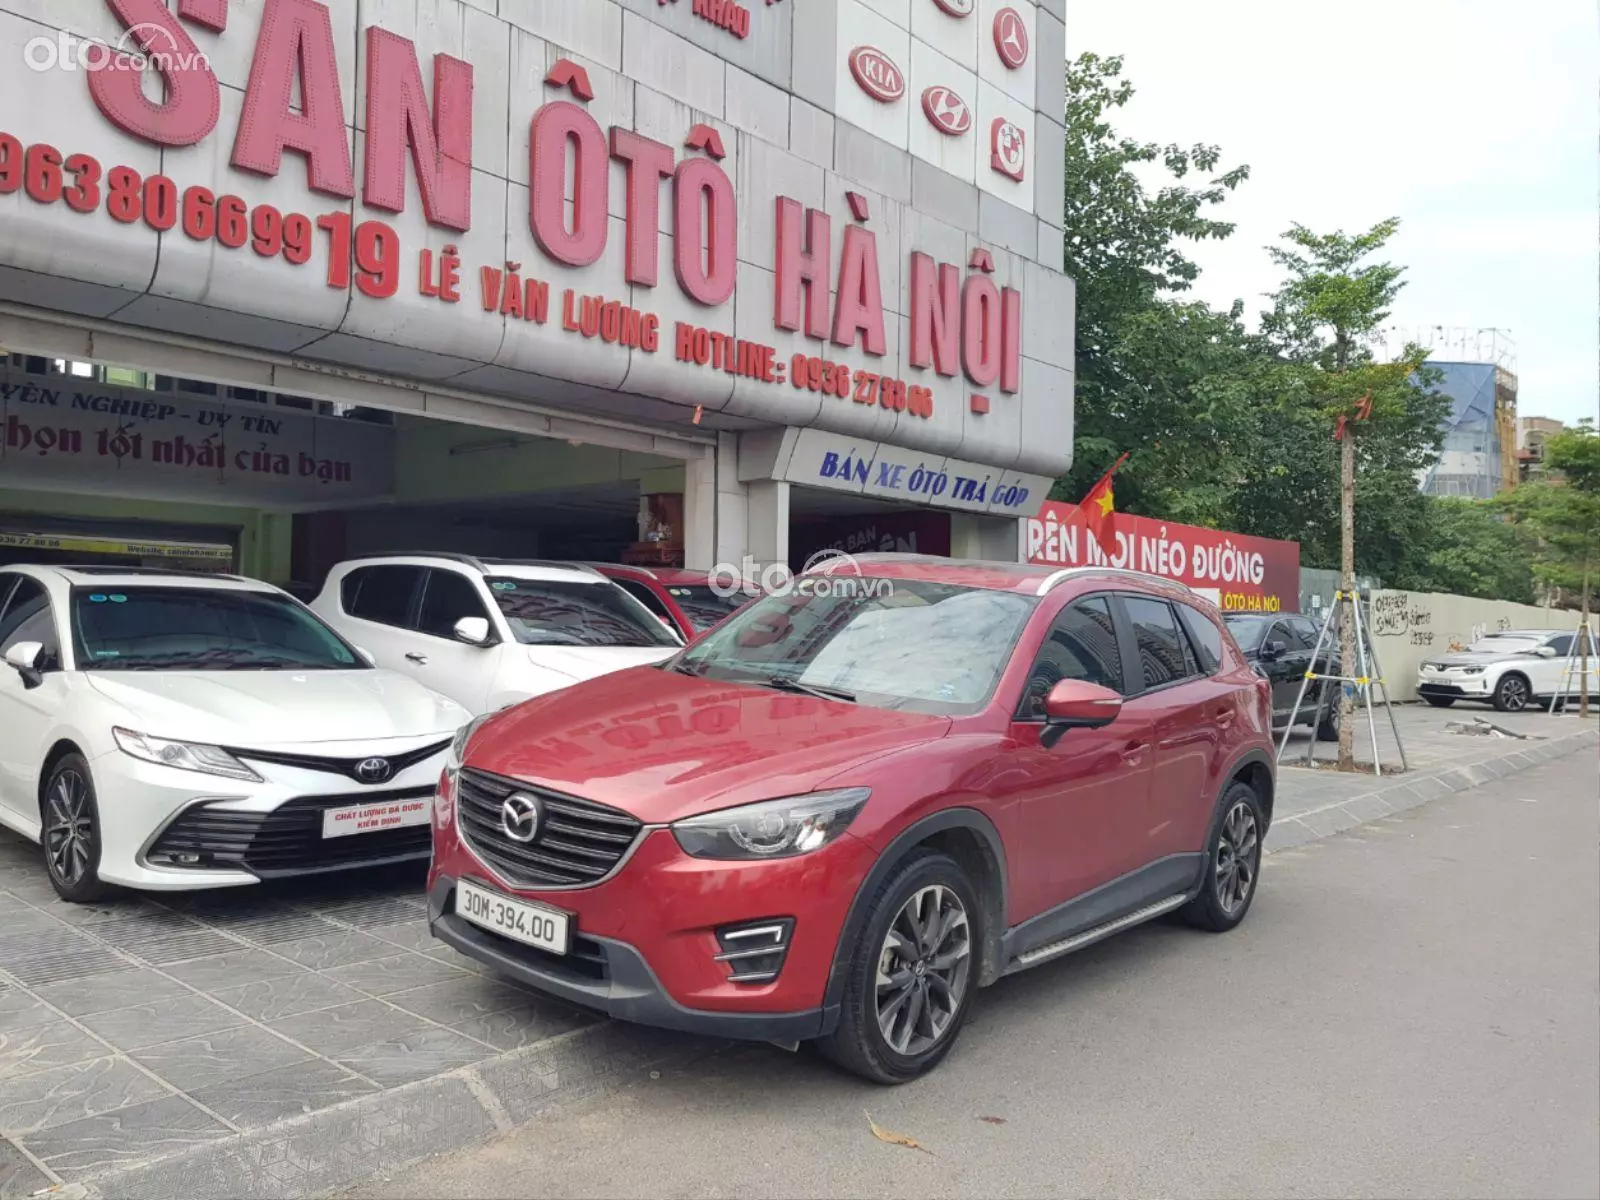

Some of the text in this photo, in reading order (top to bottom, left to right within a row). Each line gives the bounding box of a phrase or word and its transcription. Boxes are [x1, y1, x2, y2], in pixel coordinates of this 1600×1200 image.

[864, 55, 897, 91] KIA
[529, 58, 737, 306] ÔTÔ
[774, 191, 886, 357] HÀ
[910, 247, 1019, 414] NỘI
[419, 244, 460, 302] LÊ
[480, 259, 549, 324] VĂN
[563, 288, 660, 353] LƯƠNG
[675, 320, 786, 383] HOTLINE:
[71, 392, 176, 422] NGHIỆP
[0, 414, 352, 484] họn tốt nhất của bạn
[820, 448, 873, 485] BÁN
[874, 462, 906, 489] XE
[951, 474, 991, 503] TRẢ
[991, 479, 1029, 508] GÓP
[1027, 510, 1077, 564] RÊN
[1141, 525, 1186, 577] NẺO
[1192, 539, 1264, 585] ĐƯỜNG
[464, 890, 555, 943] 30M-394.00
